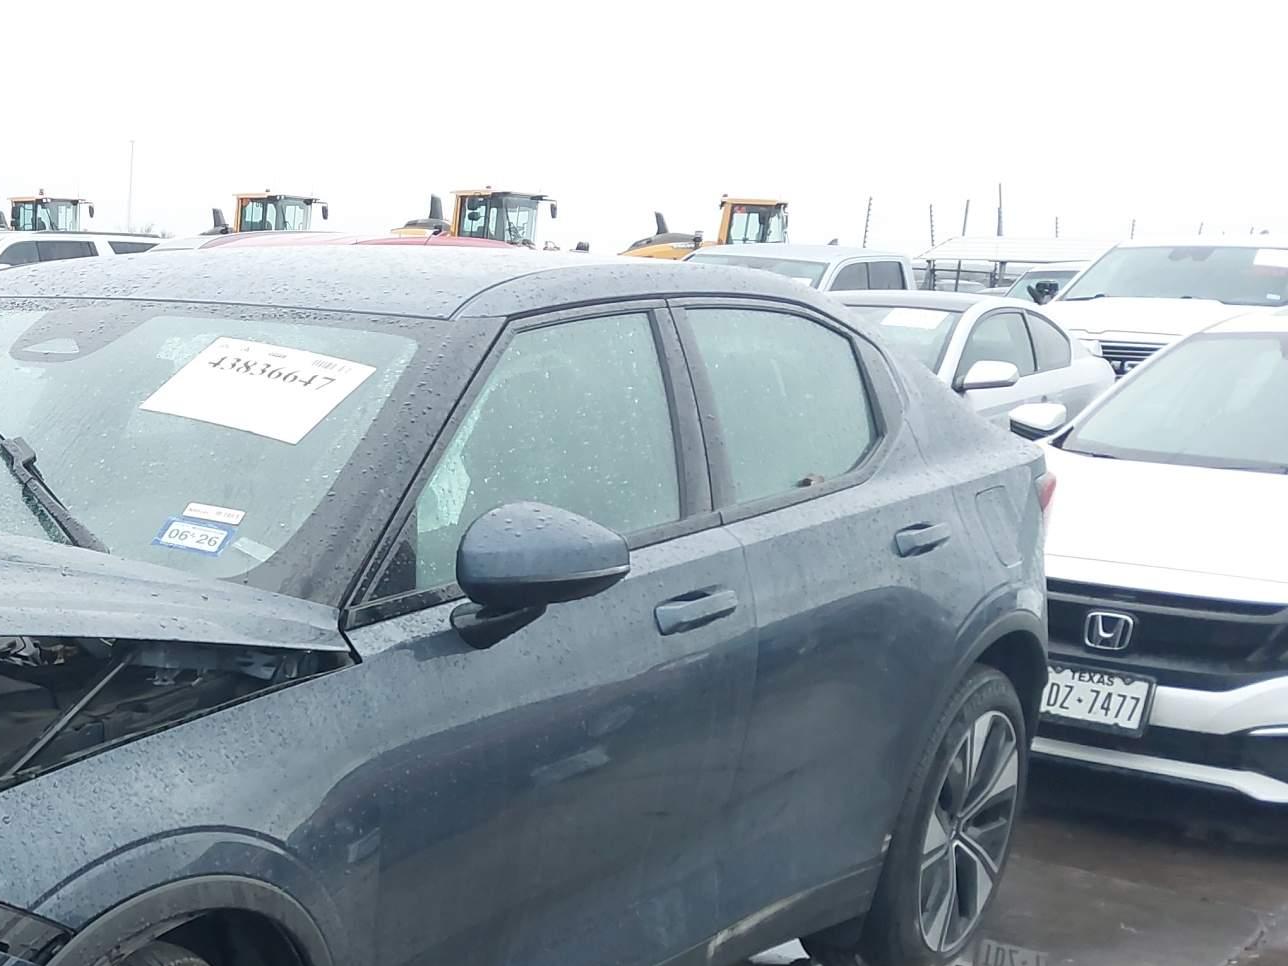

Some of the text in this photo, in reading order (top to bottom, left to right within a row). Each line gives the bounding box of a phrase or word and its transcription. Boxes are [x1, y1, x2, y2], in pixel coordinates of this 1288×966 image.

[207, 355, 337, 391] 43836647
[168, 528, 219, 547] 06 26
[1070, 670, 1115, 686] TEXAS
[1046, 682, 1074, 710] DZ
